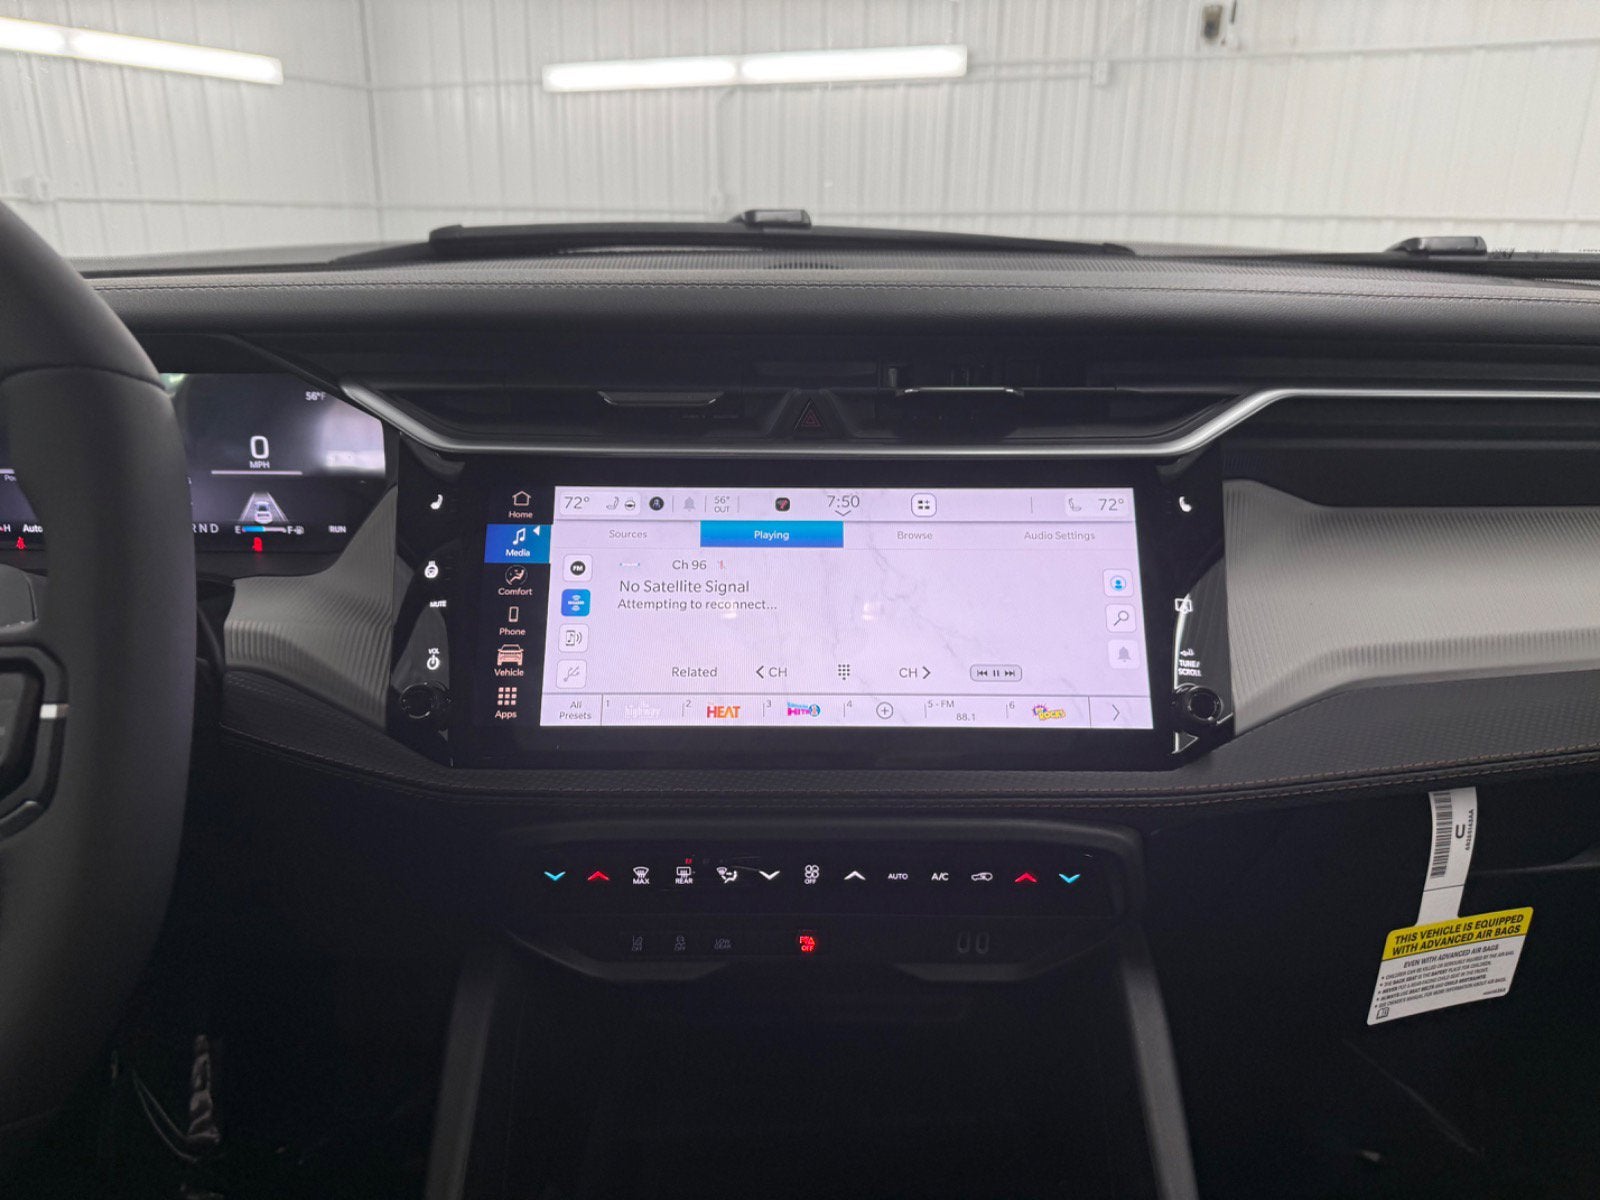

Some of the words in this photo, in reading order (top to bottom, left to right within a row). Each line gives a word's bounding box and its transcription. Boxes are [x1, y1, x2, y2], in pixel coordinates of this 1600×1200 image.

[250, 435, 270, 459] 0
[249, 461, 270, 469] MPH
[563, 495, 591, 510] 72°
[827, 495, 860, 509] 7:50
[1098, 497, 1125, 511] 72°
[714, 504, 730, 513] OUT
[508, 510, 533, 519] Home
[22, 524, 43, 532] Auto
[234, 526, 242, 534] E
[328, 525, 347, 533] RUN
[609, 529, 648, 539] Sources
[754, 529, 790, 541] Playing
[897, 530, 933, 540] Browse
[1024, 530, 1053, 540] Audio
[1055, 530, 1096, 542] Settings
[505, 548, 531, 557] Media
[672, 560, 689, 570] Ch
[692, 560, 707, 570] 96
[498, 587, 533, 596] Comfort
[620, 581, 640, 592] No
[644, 580, 701, 592] Satellite
[705, 580, 750, 595] Signal
[618, 599, 685, 611] Attempting
[688, 600, 702, 609] to
[499, 627, 526, 636] Phone
[494, 668, 524, 677] Vehicle
[672, 666, 718, 677] Related
[769, 667, 788, 677] CH
[899, 667, 918, 678] CH
[570, 700, 582, 709] All
[686, 700, 692, 708] 2
[766, 700, 772, 708] 3
[846, 700, 852, 708] 4
[928, 700, 934, 708] 5
[941, 700, 954, 708] FM
[1009, 701, 1015, 709] 6
[495, 709, 517, 720] Apps
[559, 711, 591, 721] Presets
[707, 704, 741, 718] HEAT
[956, 713, 976, 721] 88.1
[887, 872, 909, 880] AUTO
[931, 872, 950, 881] A/C
[1395, 931, 1419, 945] THIS
[1420, 924, 1461, 939] VEHICLE
[1462, 921, 1474, 932] IS
[1475, 914, 1524, 930] EQUIPPED
[1392, 943, 1419, 956] WITH
[1419, 933, 1475, 951] ADVANCED
[1476, 929, 1495, 939] AIR
[1494, 924, 1521, 937] BAGS
[1403, 958, 1421, 968] EVEN
[1421, 954, 1438, 965] WITH
[1438, 948, 1471, 962] ADVANCED
[1471, 946, 1482, 955] AIR
